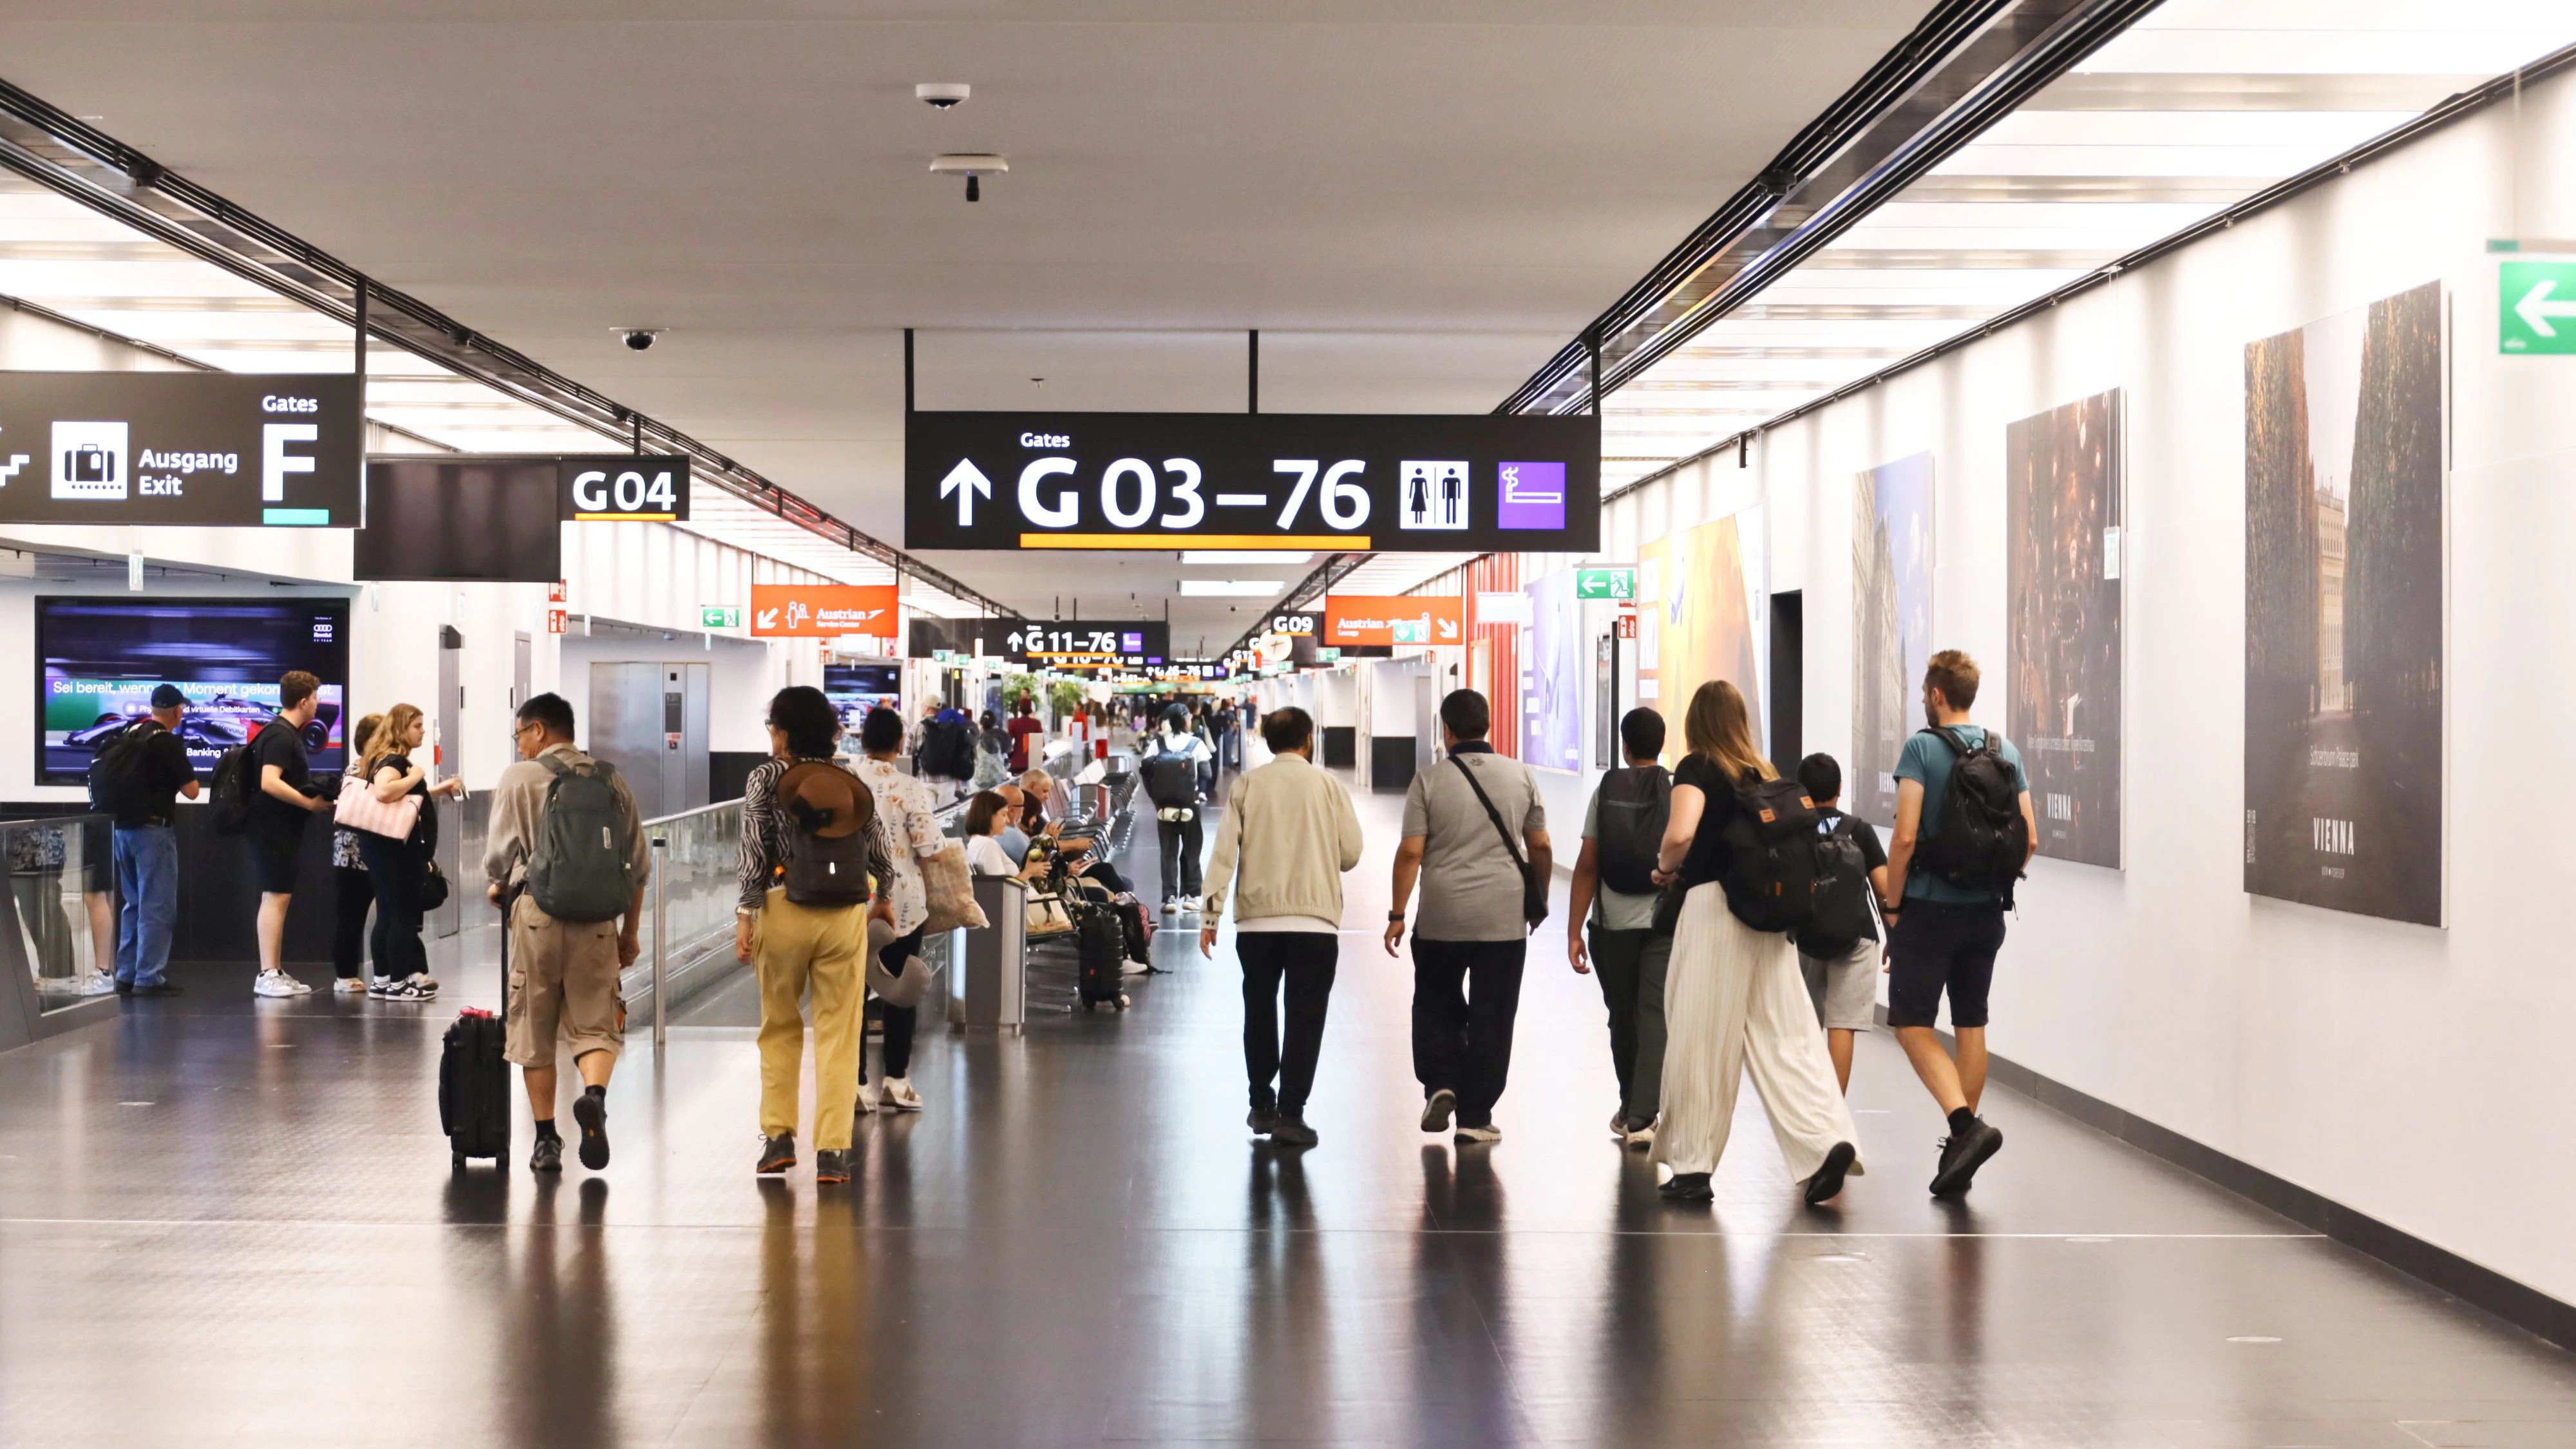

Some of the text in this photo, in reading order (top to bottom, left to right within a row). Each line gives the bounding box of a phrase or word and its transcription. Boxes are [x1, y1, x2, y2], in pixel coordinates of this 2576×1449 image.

[262, 395, 318, 412] Gates
[1020, 432, 1071, 448] Gates
[138, 449, 238, 474] Ausgang
[262, 423, 318, 502] F
[138, 474, 182, 495] Exit
[1018, 457, 1078, 527] G
[816, 608, 866, 620] Austrian
[1338, 618, 1385, 629] Austrian
[53, 681, 73, 694] Sei
[76, 681, 116, 696] bereit,
[183, 683, 237, 695] Moment
[187, 747, 222, 759] Banking
[2047, 793, 2071, 821] VIENNA
[2313, 817, 2354, 855] VIENNA
